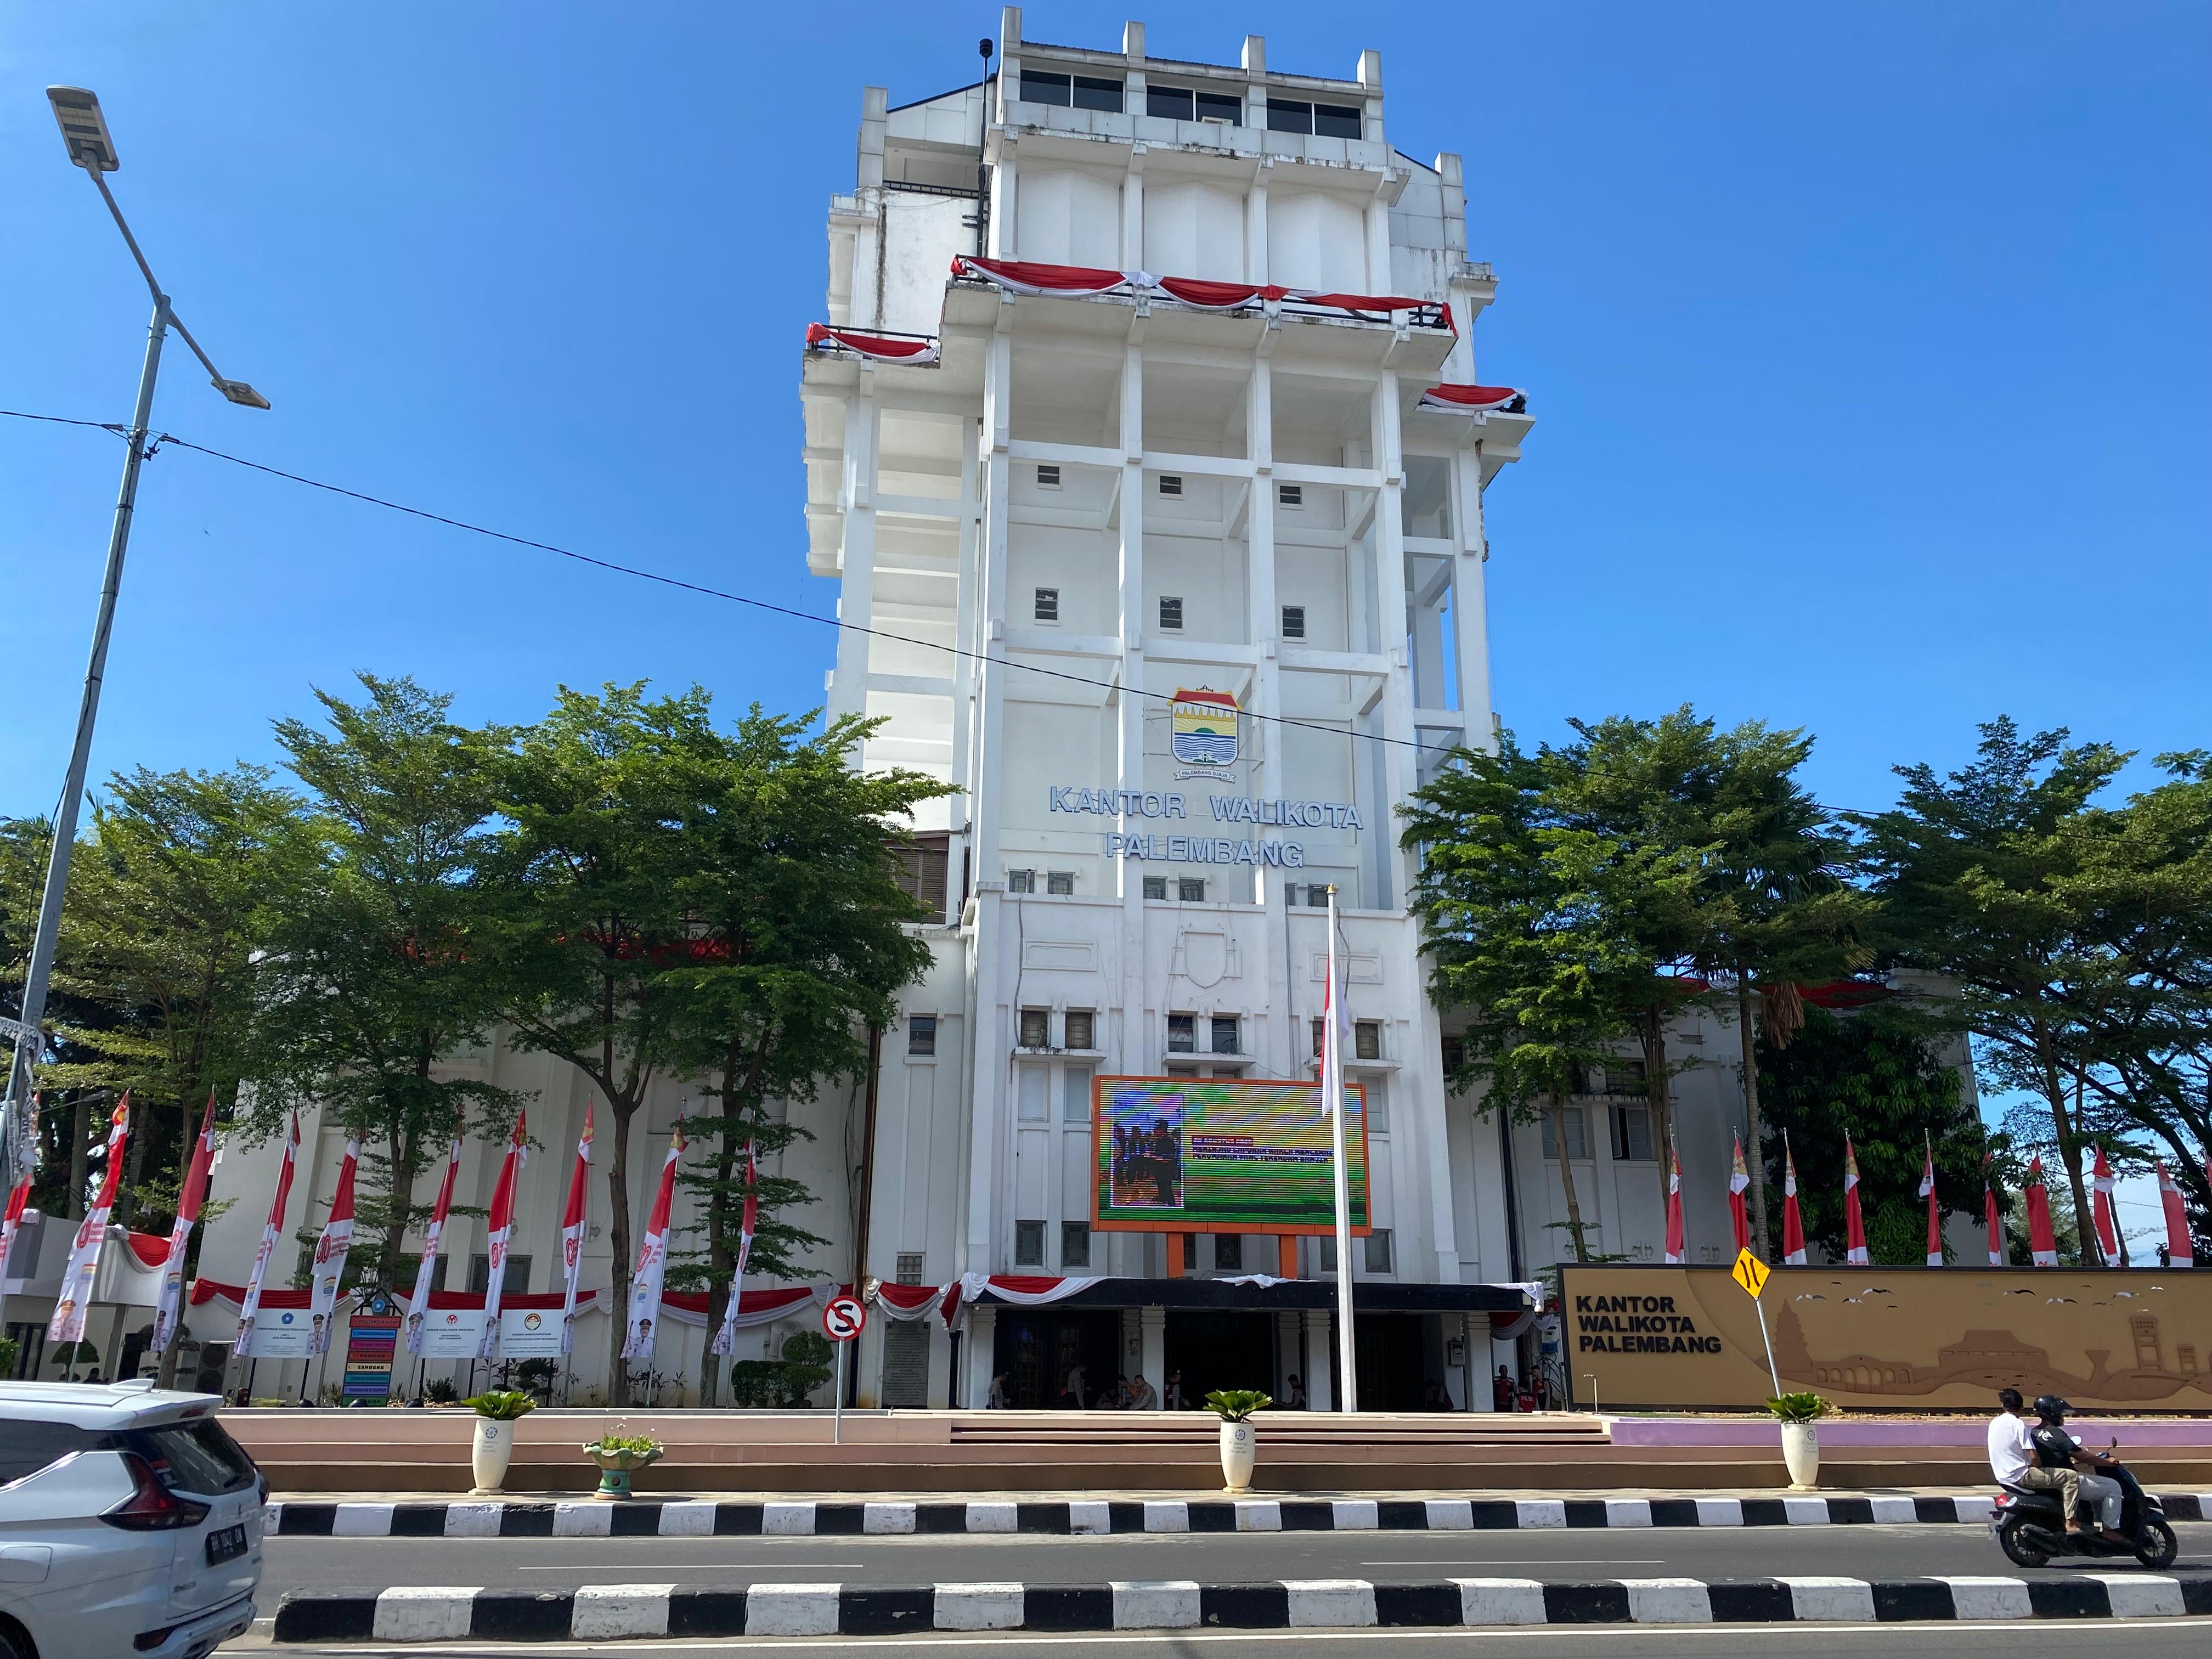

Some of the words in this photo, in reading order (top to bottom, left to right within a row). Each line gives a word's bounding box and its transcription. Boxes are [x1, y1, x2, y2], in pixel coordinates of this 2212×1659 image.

[1050, 786, 1186, 819] KANTOR
[1210, 795, 1364, 830] WALIKOTA
[1107, 832, 1304, 868] PALEMBANG
[1576, 1296, 1675, 1312] KANTOR
[834, 1304, 855, 1332] S
[1578, 1315, 1696, 1333] WALIKOTA
[1579, 1335, 1722, 1353] PALEMBANG
